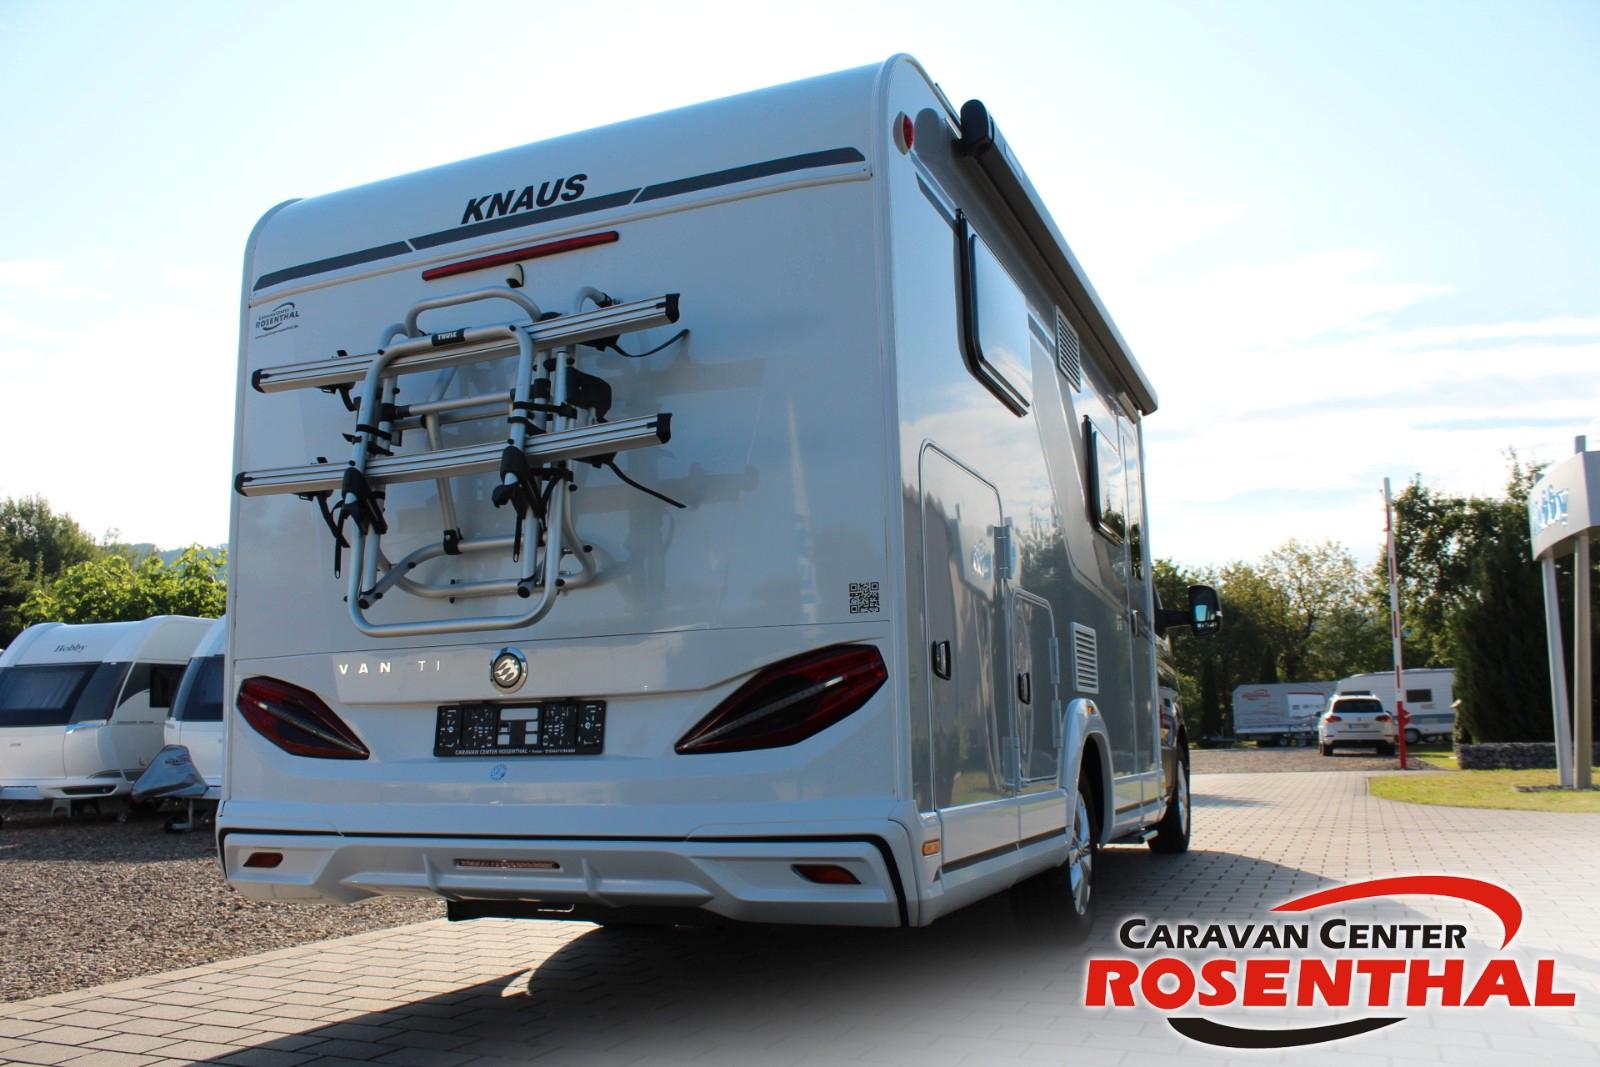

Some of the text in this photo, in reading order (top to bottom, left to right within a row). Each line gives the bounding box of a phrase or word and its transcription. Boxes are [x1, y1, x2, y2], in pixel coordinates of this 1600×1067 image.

[461, 173, 588, 225] KNAUS
[255, 310, 300, 329] ROSENTHAL
[338, 659, 441, 676] VAN TI
